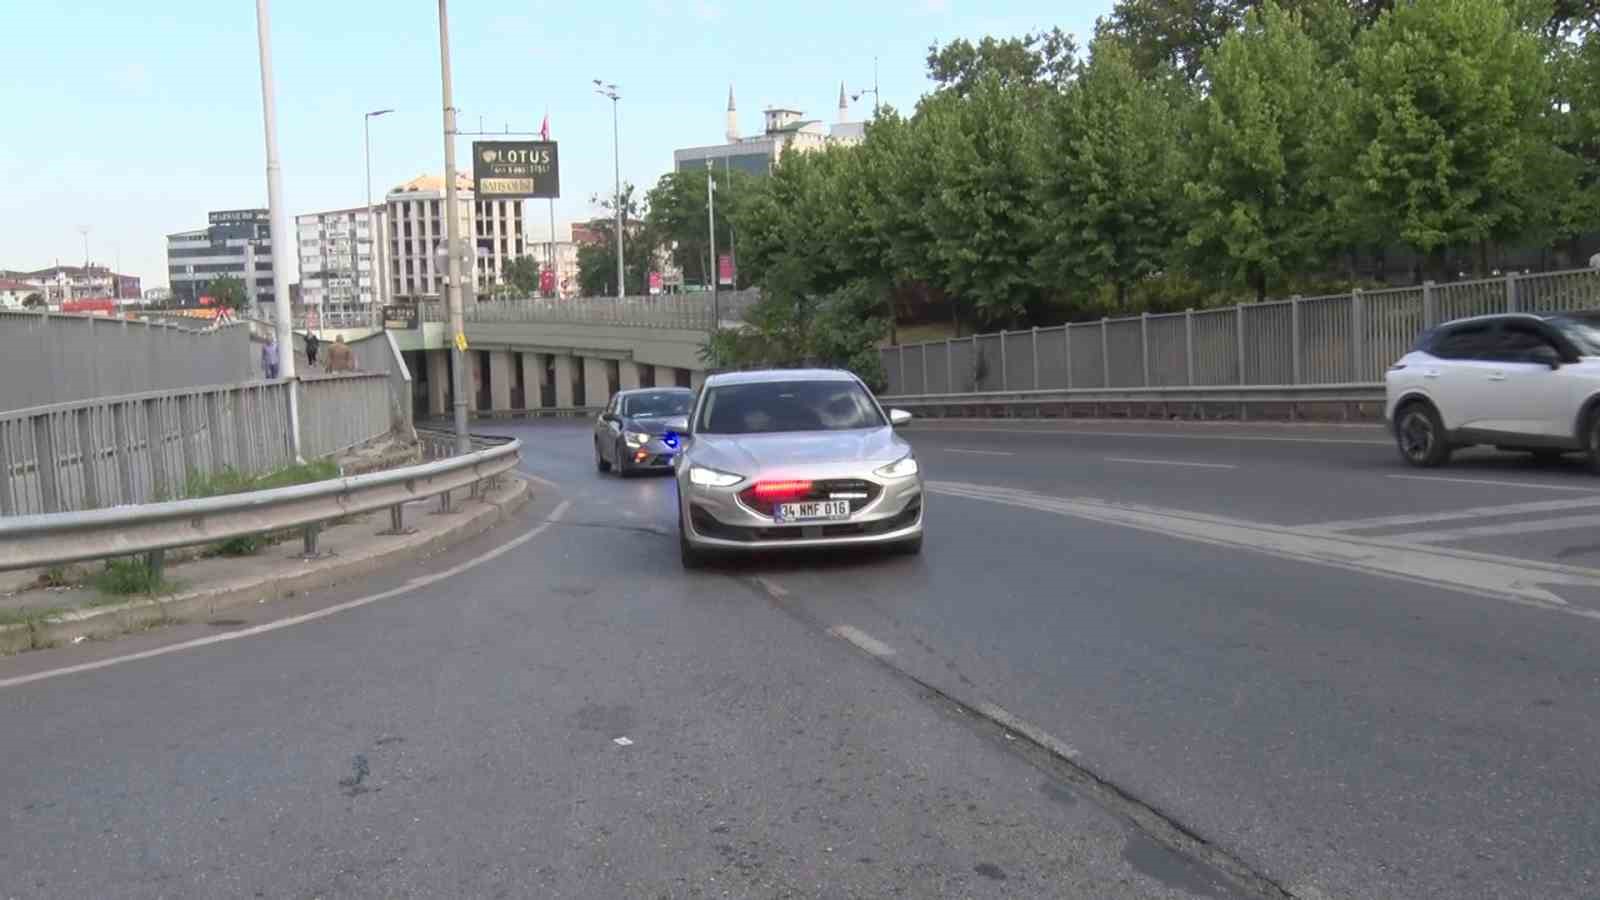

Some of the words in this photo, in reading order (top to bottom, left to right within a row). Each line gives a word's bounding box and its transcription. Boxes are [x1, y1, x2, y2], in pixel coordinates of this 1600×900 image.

[498, 150, 550, 164] LOTUS
[783, 504, 795, 518] 34
[799, 503, 820, 517] NMF
[825, 501, 846, 515] 016
